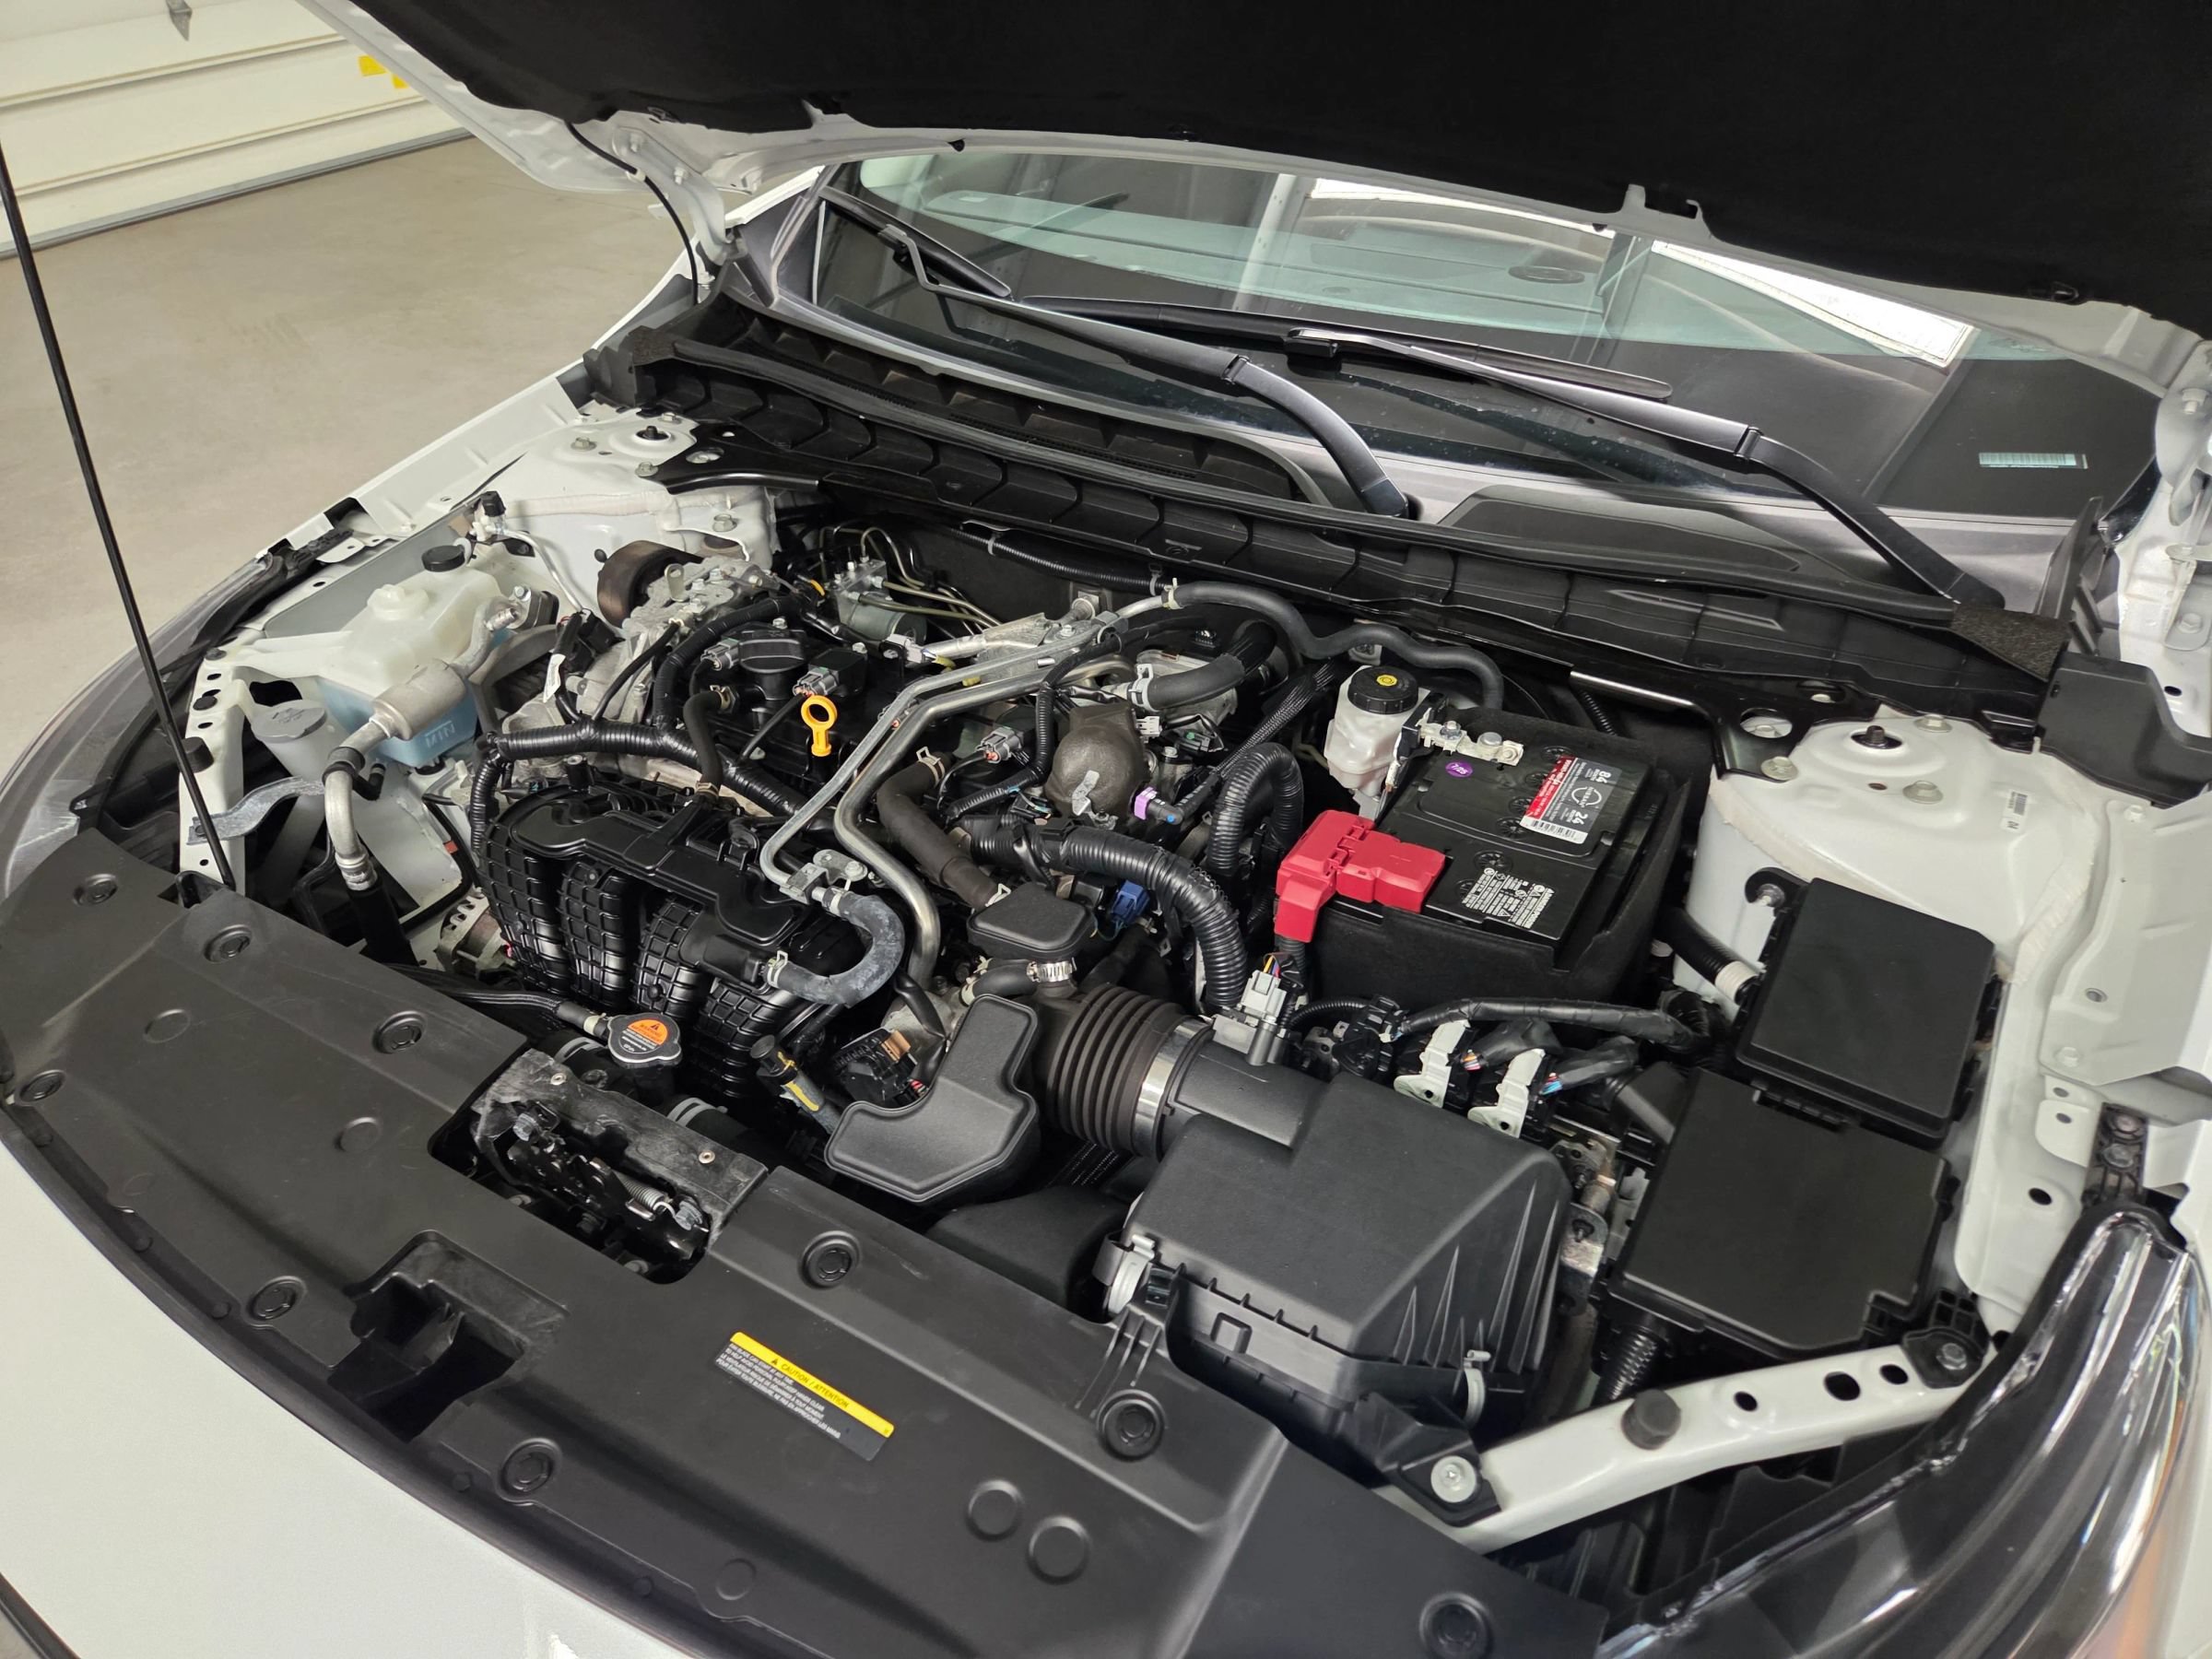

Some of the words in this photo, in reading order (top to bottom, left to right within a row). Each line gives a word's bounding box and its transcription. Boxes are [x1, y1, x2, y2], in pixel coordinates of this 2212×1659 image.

[425, 724, 455, 748] MIN
[1594, 770, 1612, 783] 84
[1578, 785, 1594, 806] NISSAN
[1571, 810, 1588, 826] 24
[780, 1362, 809, 1383] CAUTION
[812, 1382, 849, 1408] ATTENTION
